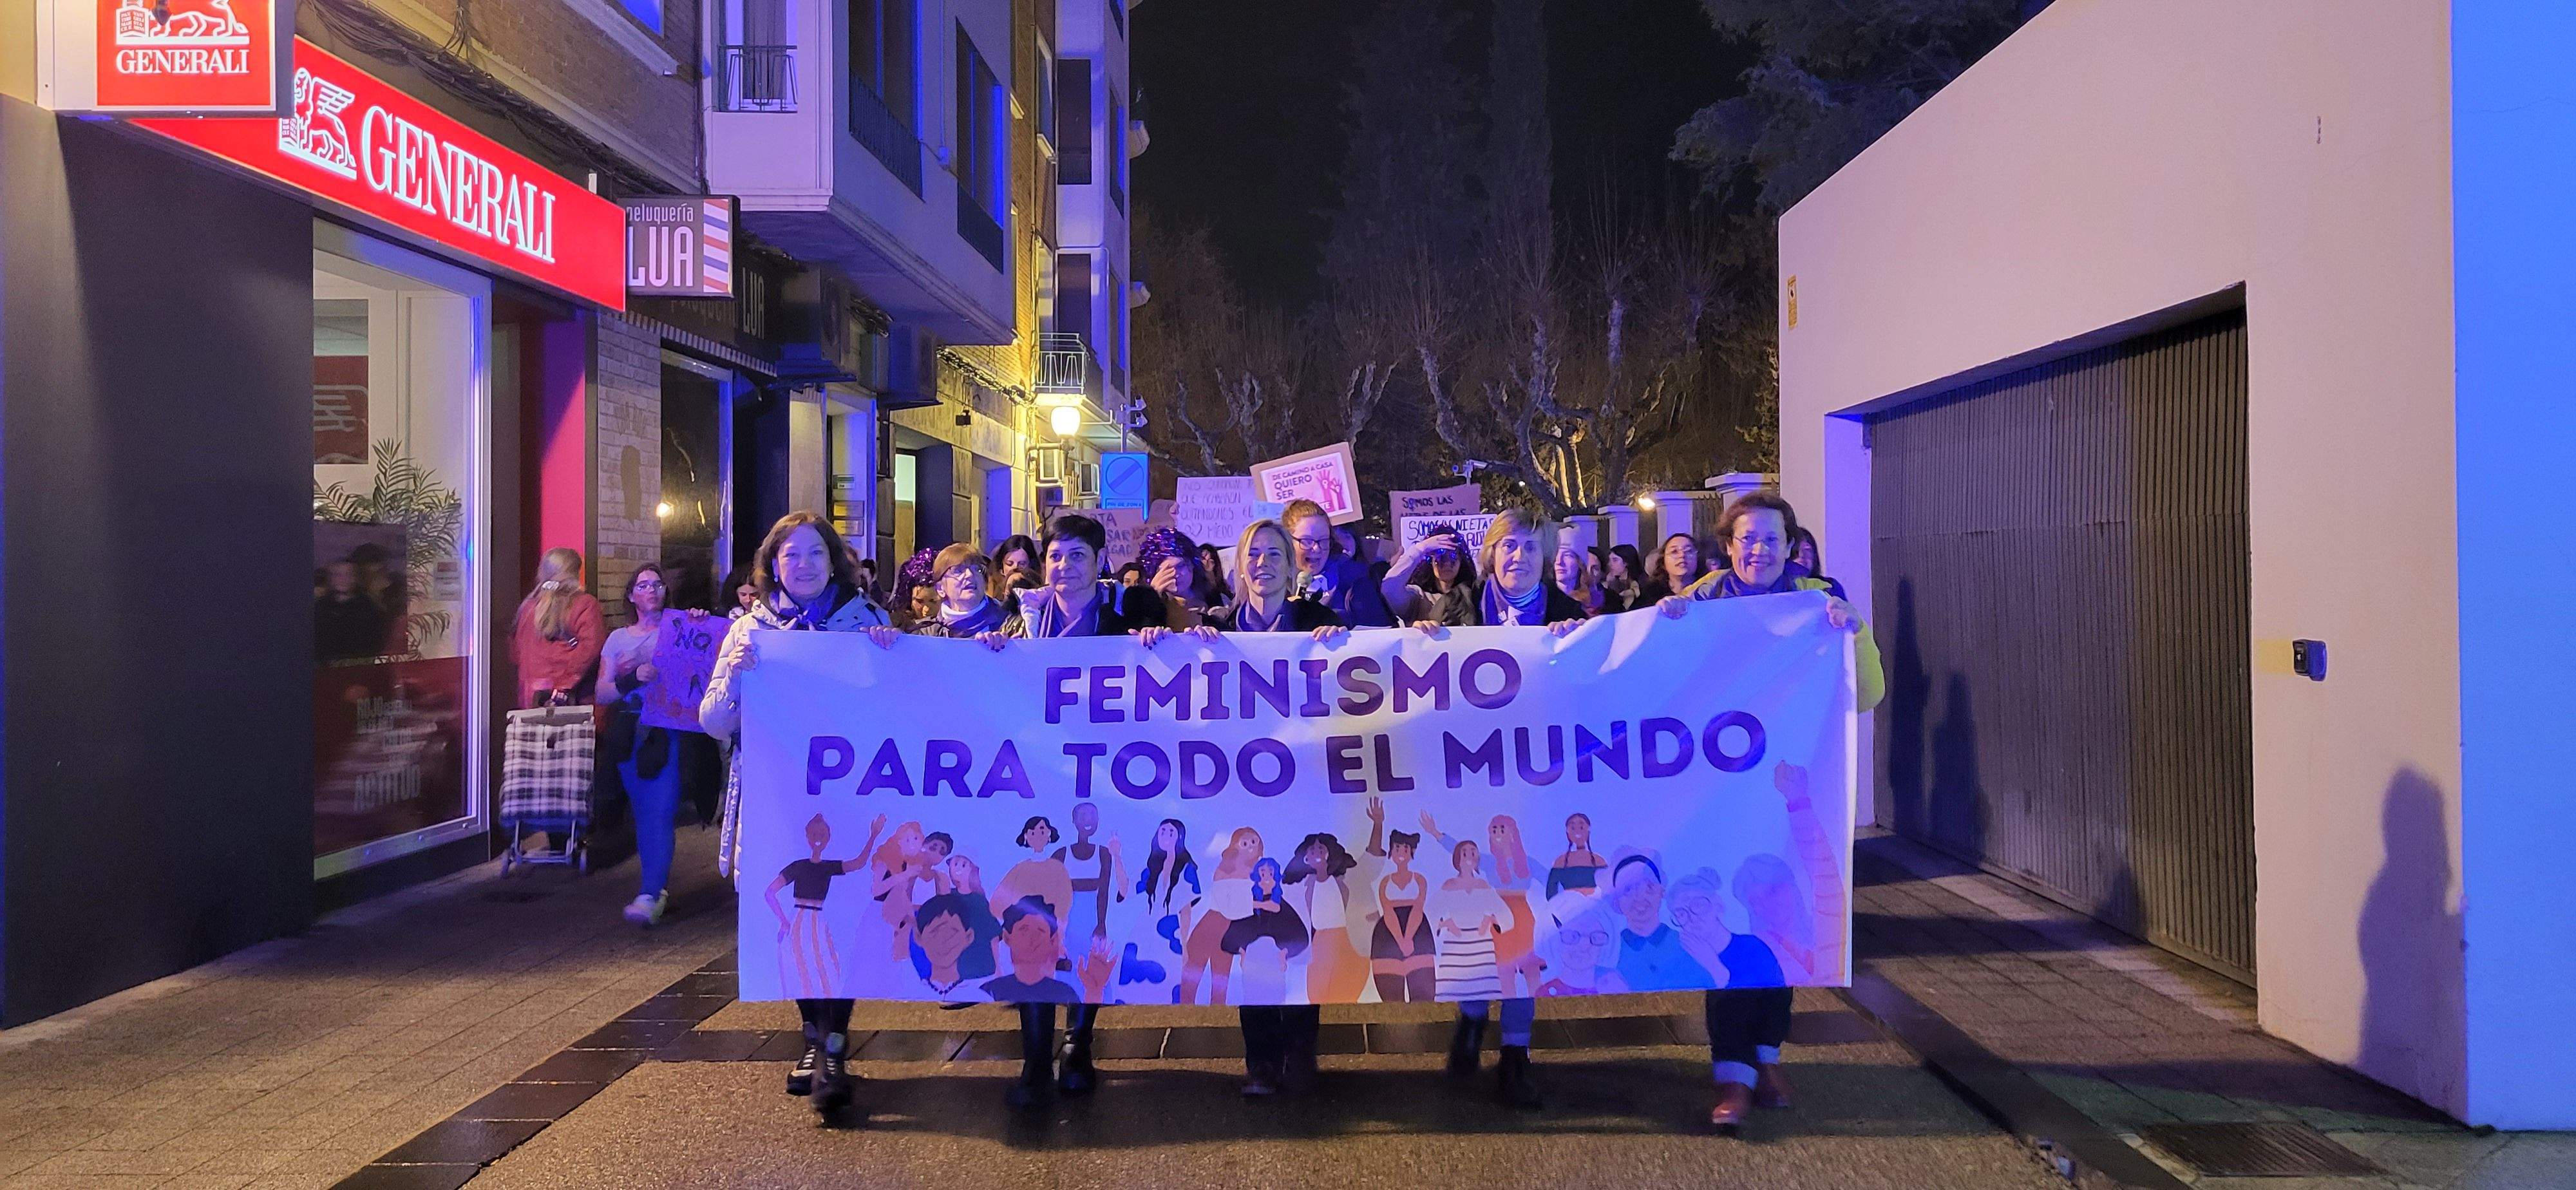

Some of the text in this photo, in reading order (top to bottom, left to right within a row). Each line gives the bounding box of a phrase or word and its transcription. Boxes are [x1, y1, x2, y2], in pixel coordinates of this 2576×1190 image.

[116, 49, 250, 74] GENERALI
[361, 105, 556, 264] GENERALI
[628, 225, 694, 287] LUA
[742, 266, 765, 341] LUA
[1274, 474, 1312, 491] QUIERO
[1282, 467, 1310, 478] CAMINO
[1316, 461, 1334, 470] CASA
[1276, 489, 1294, 500] SER
[1436, 495, 1454, 505] LAS
[1044, 648, 1522, 724] FEMINISMO
[806, 710, 1766, 800] PARA TODO EL MUNDO
